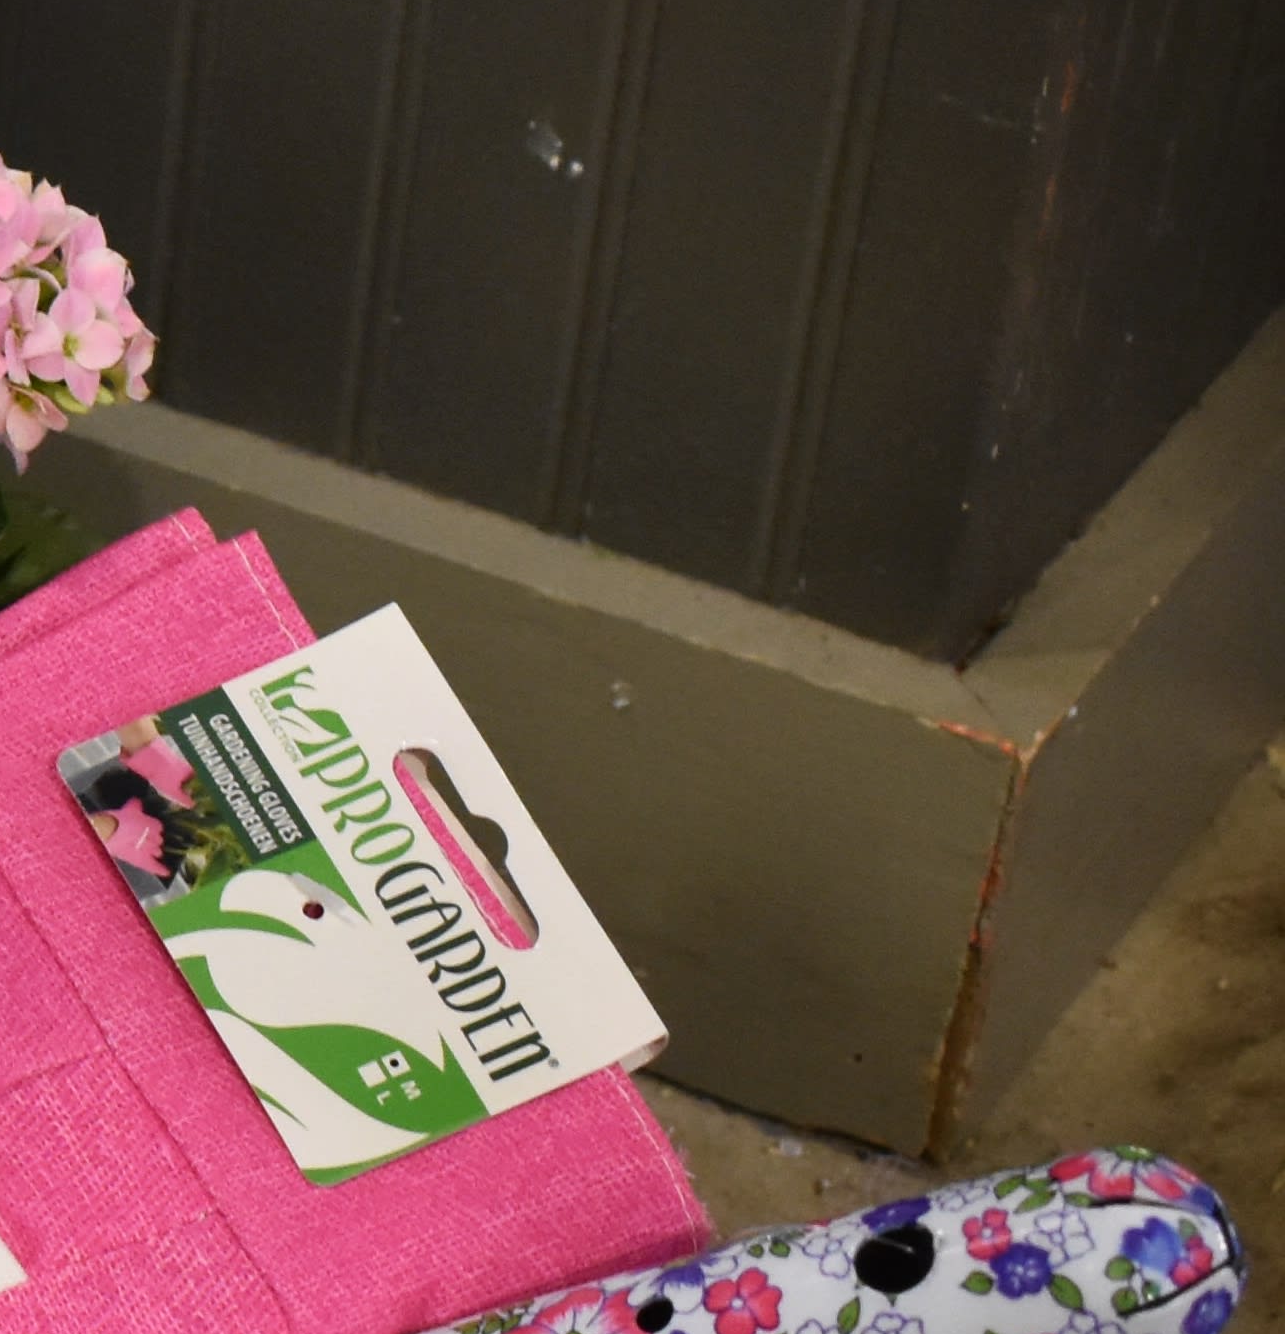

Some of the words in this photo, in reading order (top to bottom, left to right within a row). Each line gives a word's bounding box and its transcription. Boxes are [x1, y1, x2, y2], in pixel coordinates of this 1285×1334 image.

[249, 688, 300, 763] COLLECTION
[178, 713, 278, 855] TUINHANDSCHOENEN
[209, 714, 271, 793] GARDENING
[258, 790, 303, 844] GLOVES
[376, 1090, 391, 1106] L
[400, 1080, 422, 1100] M
